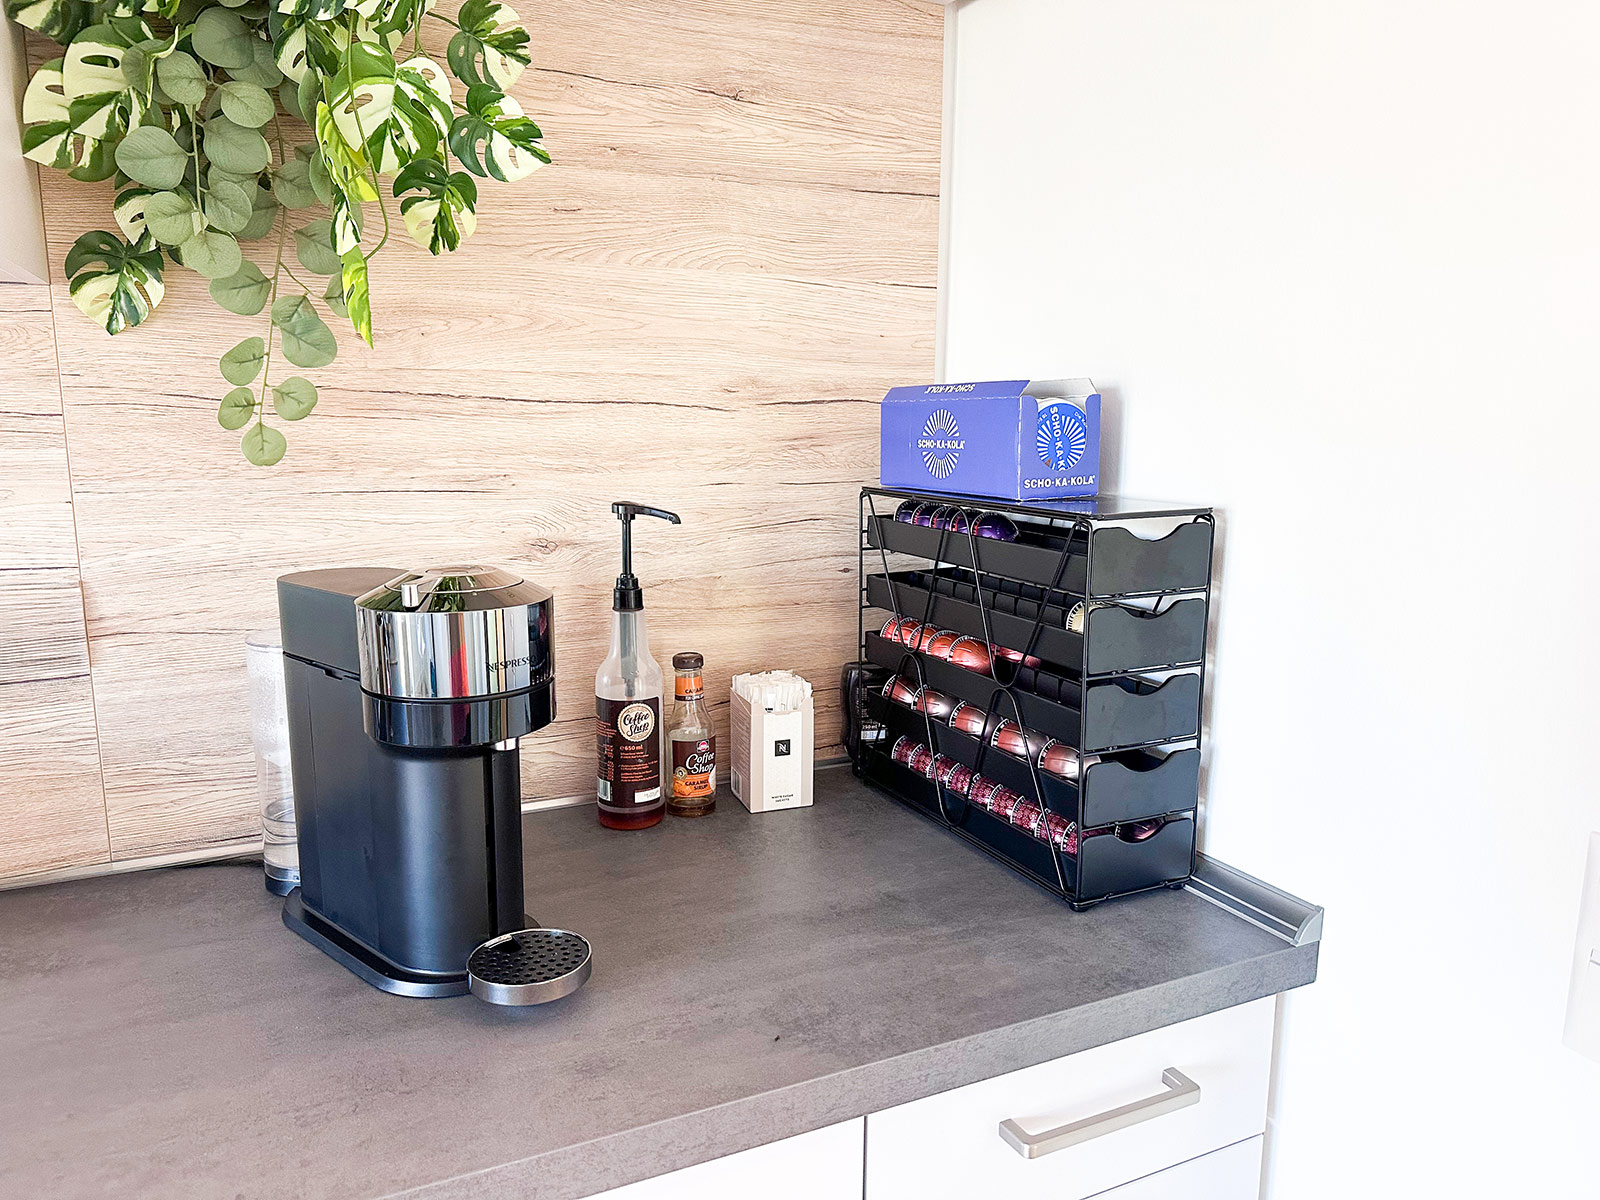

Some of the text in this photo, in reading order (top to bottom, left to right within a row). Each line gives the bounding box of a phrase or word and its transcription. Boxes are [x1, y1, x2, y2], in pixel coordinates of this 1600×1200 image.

[485, 655, 537, 673] NESPRESSO
[623, 711, 650, 726] Coffee
[627, 723, 649, 737] Shop
[685, 752, 714, 770] Coffee
[691, 763, 713, 774] Shop
